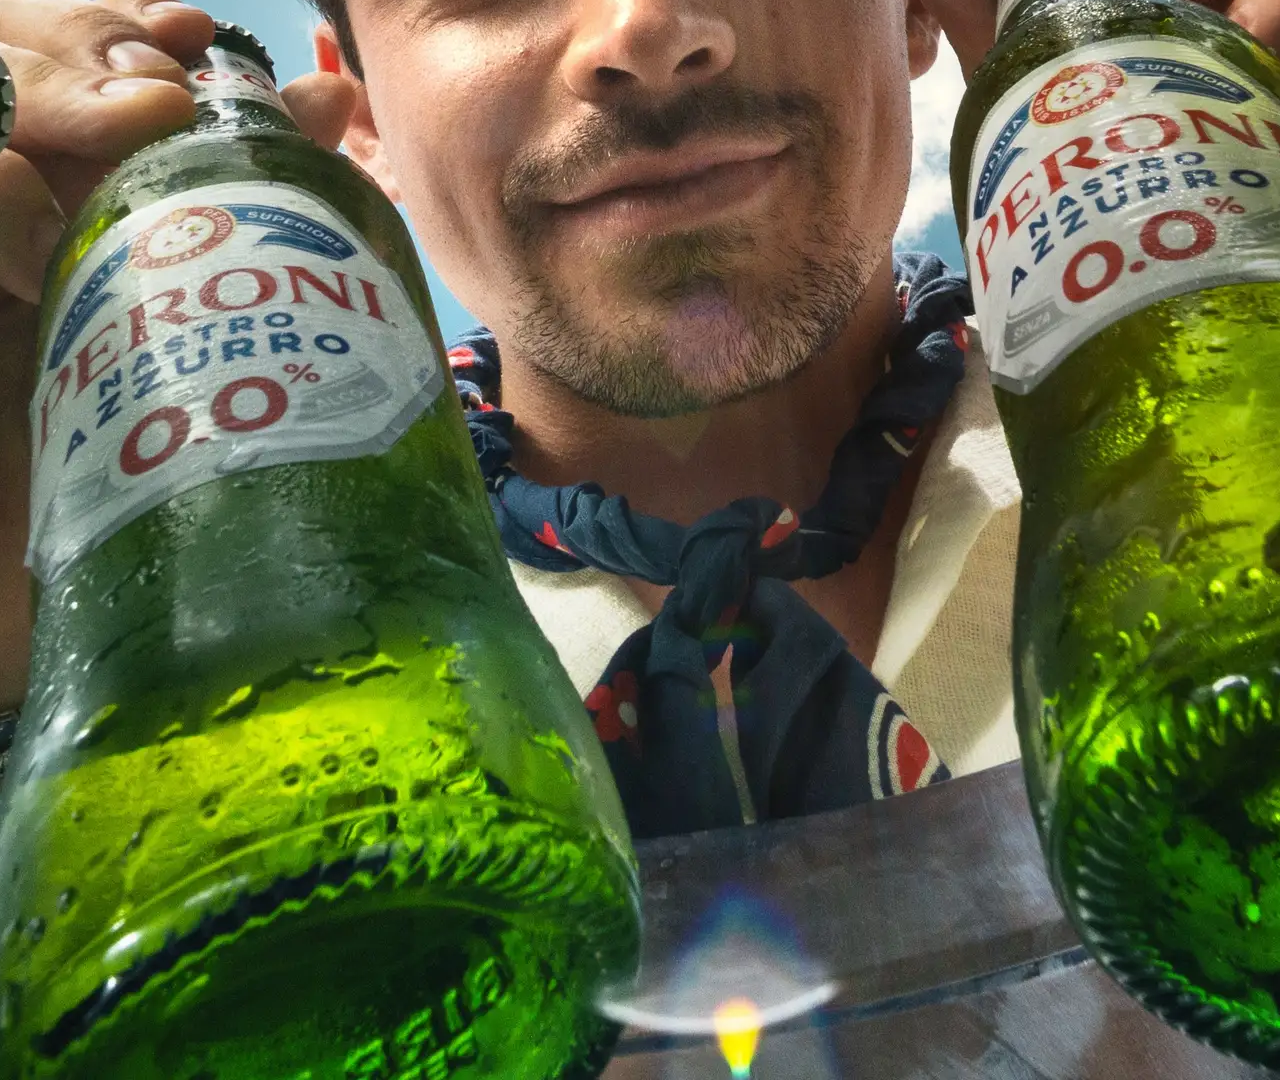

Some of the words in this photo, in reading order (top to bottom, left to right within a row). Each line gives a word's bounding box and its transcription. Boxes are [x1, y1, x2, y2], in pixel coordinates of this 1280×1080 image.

[1135, 62, 1240, 95] SUPERIORE
[978, 118, 1023, 201] QUALITA
[1028, 151, 1206, 239] NASTRO
[246, 209, 345, 251] SUPERIORE
[1011, 169, 1270, 299] AZZURRO
[39, 265, 387, 458] PERONI
[64, 332, 351, 466] AZZURRO
[98, 311, 295, 399] NASTRO
